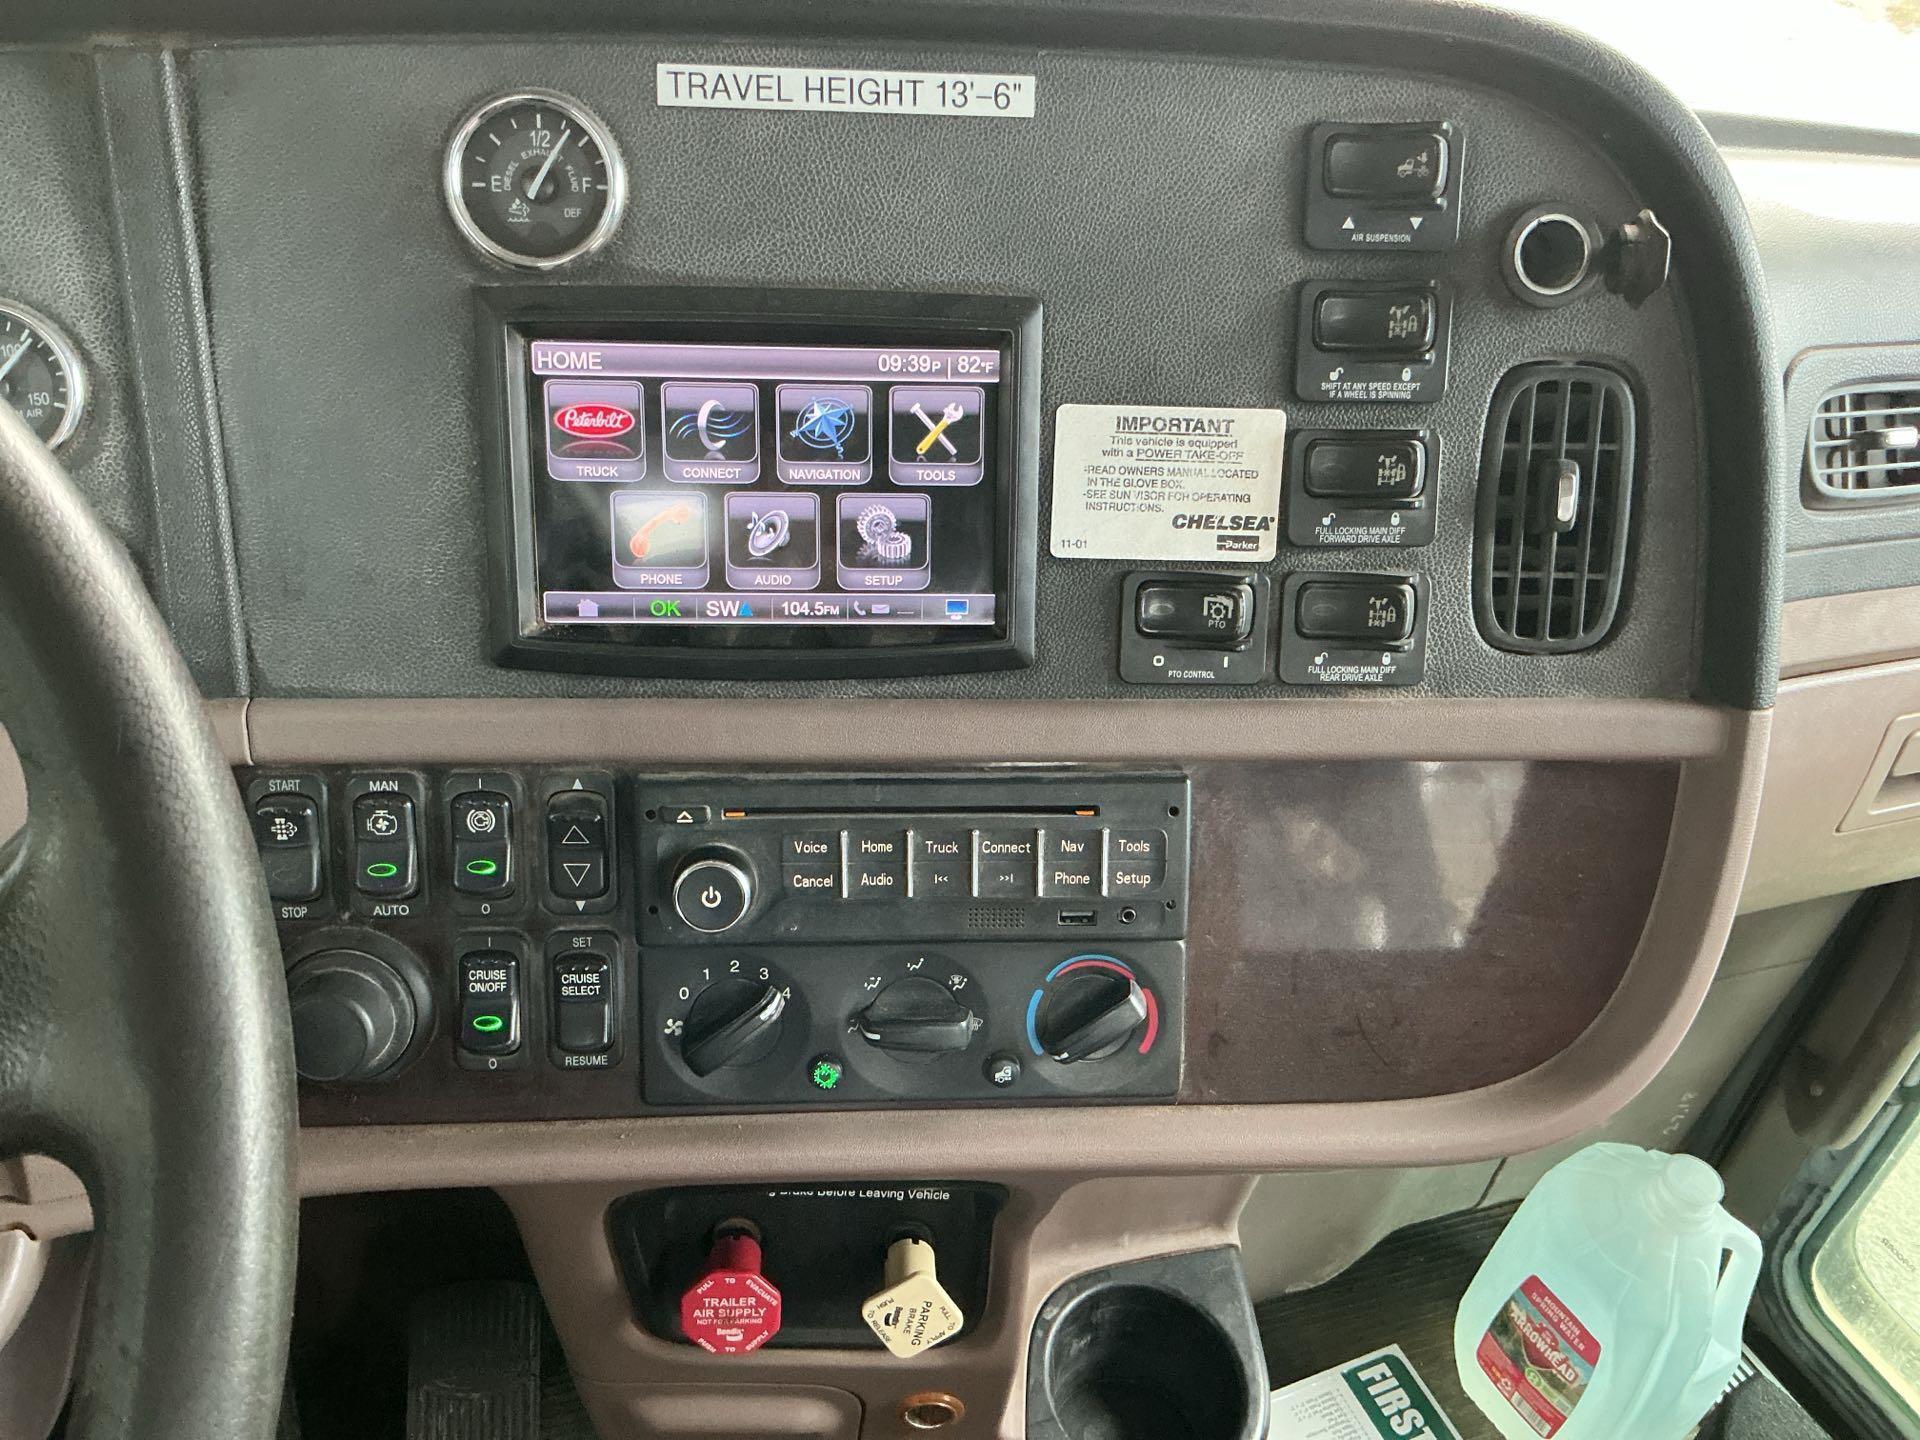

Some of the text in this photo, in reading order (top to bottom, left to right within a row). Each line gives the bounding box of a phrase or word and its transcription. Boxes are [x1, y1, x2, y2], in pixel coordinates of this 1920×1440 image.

[666, 70, 794, 103] TRAVEL
[804, 75, 925, 107] HEIGHT
[530, 130, 551, 147] 1/2
[520, 148, 565, 162] EXHAT
[491, 175, 502, 192] E
[582, 177, 592, 193] F
[564, 208, 582, 218] DEF
[1351, 233, 1411, 243] AIR SUSPENSION
[537, 351, 603, 370] HOME
[1321, 382, 1421, 391] SHIFT AT ANY SPEED EXCEPT
[27, 391, 50, 406] 150
[1329, 390, 1412, 399] IF A WHEEL IS SPINNING
[26, 409, 44, 418] AIR
[563, 407, 630, 430] Peterbilt
[1116, 415, 1235, 434] IMPORTANT
[1110, 435, 1238, 450] This vehicle is equipped
[1101, 447, 1245, 461] with a POWER TAKE-OFF
[576, 465, 619, 478] TRUCK
[683, 467, 742, 479] CONNECT
[789, 468, 861, 481] NAVIGATION
[917, 469, 956, 481] TOOLS
[1118, 465, 1165, 476] OWNERS
[1166, 466, 1209, 477] MANUAL
[1211, 468, 1259, 479] LOCATED
[1087, 477, 1098, 486] IN
[1100, 477, 1121, 487] THE
[1123, 478, 1159, 488] GLOVE
[1109, 490, 1131, 500] SUN
[1133, 490, 1166, 501] VISOR
[1168, 491, 1190, 501] FOR
[1192, 492, 1251, 503] OPERATING
[1171, 513, 1271, 532] CHELSEA
[1315, 526, 1406, 535] FULL LOCKING MAIN DIFF
[1061, 539, 1088, 549] 11-01
[1224, 540, 1258, 550] Parker
[1319, 535, 1401, 544] FORWARD DRIVE AXLE
[640, 574, 683, 585] PHONE
[754, 574, 792, 585] AUDIO
[864, 575, 903, 586] SETUP
[650, 599, 682, 617] OK
[706, 600, 740, 617] SW
[1207, 620, 1226, 629] PTO
[1168, 670, 1215, 679] PTO CONTROL
[1308, 665, 1397, 674] FULL LOCKING MAIN DIFF
[1319, 674, 1384, 682] REAR DRIVE AXLE
[269, 779, 301, 791] START
[369, 780, 399, 792] MAN
[794, 840, 828, 854] Voice
[861, 839, 893, 853] Home
[925, 840, 959, 854] Truck
[982, 840, 1031, 854] Connect
[1061, 839, 1085, 853] Nav
[1118, 839, 1150, 852] Tools
[793, 874, 834, 888] Cancel
[860, 872, 893, 886] Audio
[1054, 871, 1090, 885] Phone
[1115, 871, 1151, 888] Setup
[282, 907, 308, 918] STOP
[373, 904, 410, 917] AUTO
[572, 937, 593, 948] SET
[729, 960, 740, 973] 2
[468, 969, 507, 981] CRUISE
[561, 973, 600, 984] CRUISE
[702, 968, 710, 980] 1
[759, 967, 769, 980] 3
[469, 981, 507, 993] ON/OFF
[561, 985, 601, 996] SELECT
[679, 986, 690, 1000] 0
[782, 987, 791, 999] 4
[565, 1055, 609, 1067] RESUME
[859, 1190, 904, 1200] Leaving
[908, 1189, 950, 1200] Vehicle
[697, 1280, 715, 1295] PULL
[745, 1279, 778, 1306] EVACUATE
[703, 1297, 757, 1307] TRAILER
[693, 1307, 767, 1318] AIR SUPPLY
[1543, 1295, 1581, 1336] MOUNTAIN
[903, 1307, 917, 1335] BRAKE
[911, 1300, 933, 1346] PARKING
[1531, 1292, 1559, 1323] SPRING
[1559, 1321, 1586, 1351] WATER
[871, 1320, 892, 1343] RELEASE
[697, 1337, 717, 1353] PUSH
[1511, 1311, 1577, 1383] ARROWHEAD
